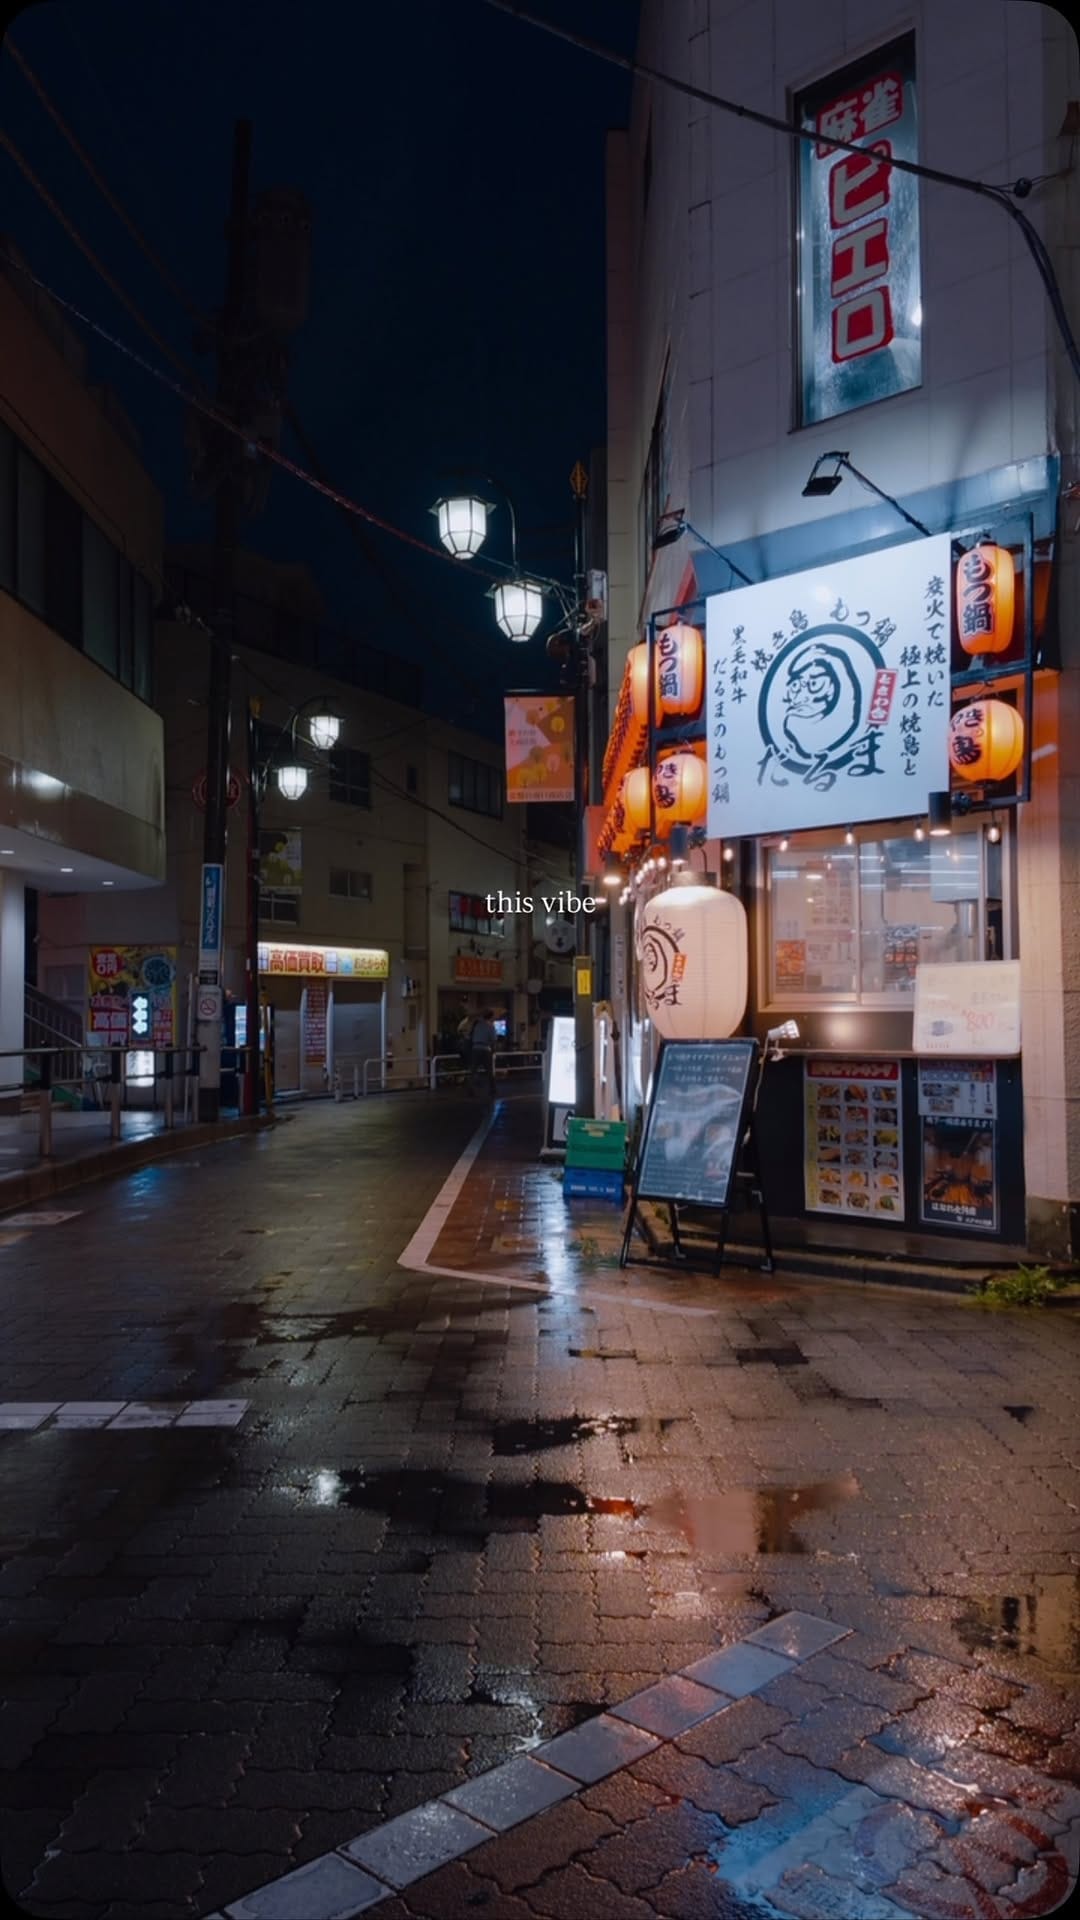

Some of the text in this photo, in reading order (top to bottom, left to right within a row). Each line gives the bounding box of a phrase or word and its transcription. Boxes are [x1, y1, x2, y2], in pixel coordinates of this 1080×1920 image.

[818, 78, 900, 155] 麻雀
[832, 144, 888, 357] ピエロ
[829, 597, 898, 648] もつ鍋
[962, 553, 994, 635] もつ鍋
[658, 632, 679, 698] もつ鍋
[731, 624, 749, 705] 黒毛和牛
[923, 575, 947, 708] 炭火で焼いた
[711, 658, 730, 805] だるまのもつ鍋
[899, 646, 922, 777] 極上の焼鳥と
[756, 724, 886, 793] だるま
[270, 949, 325, 973] 高価買取
